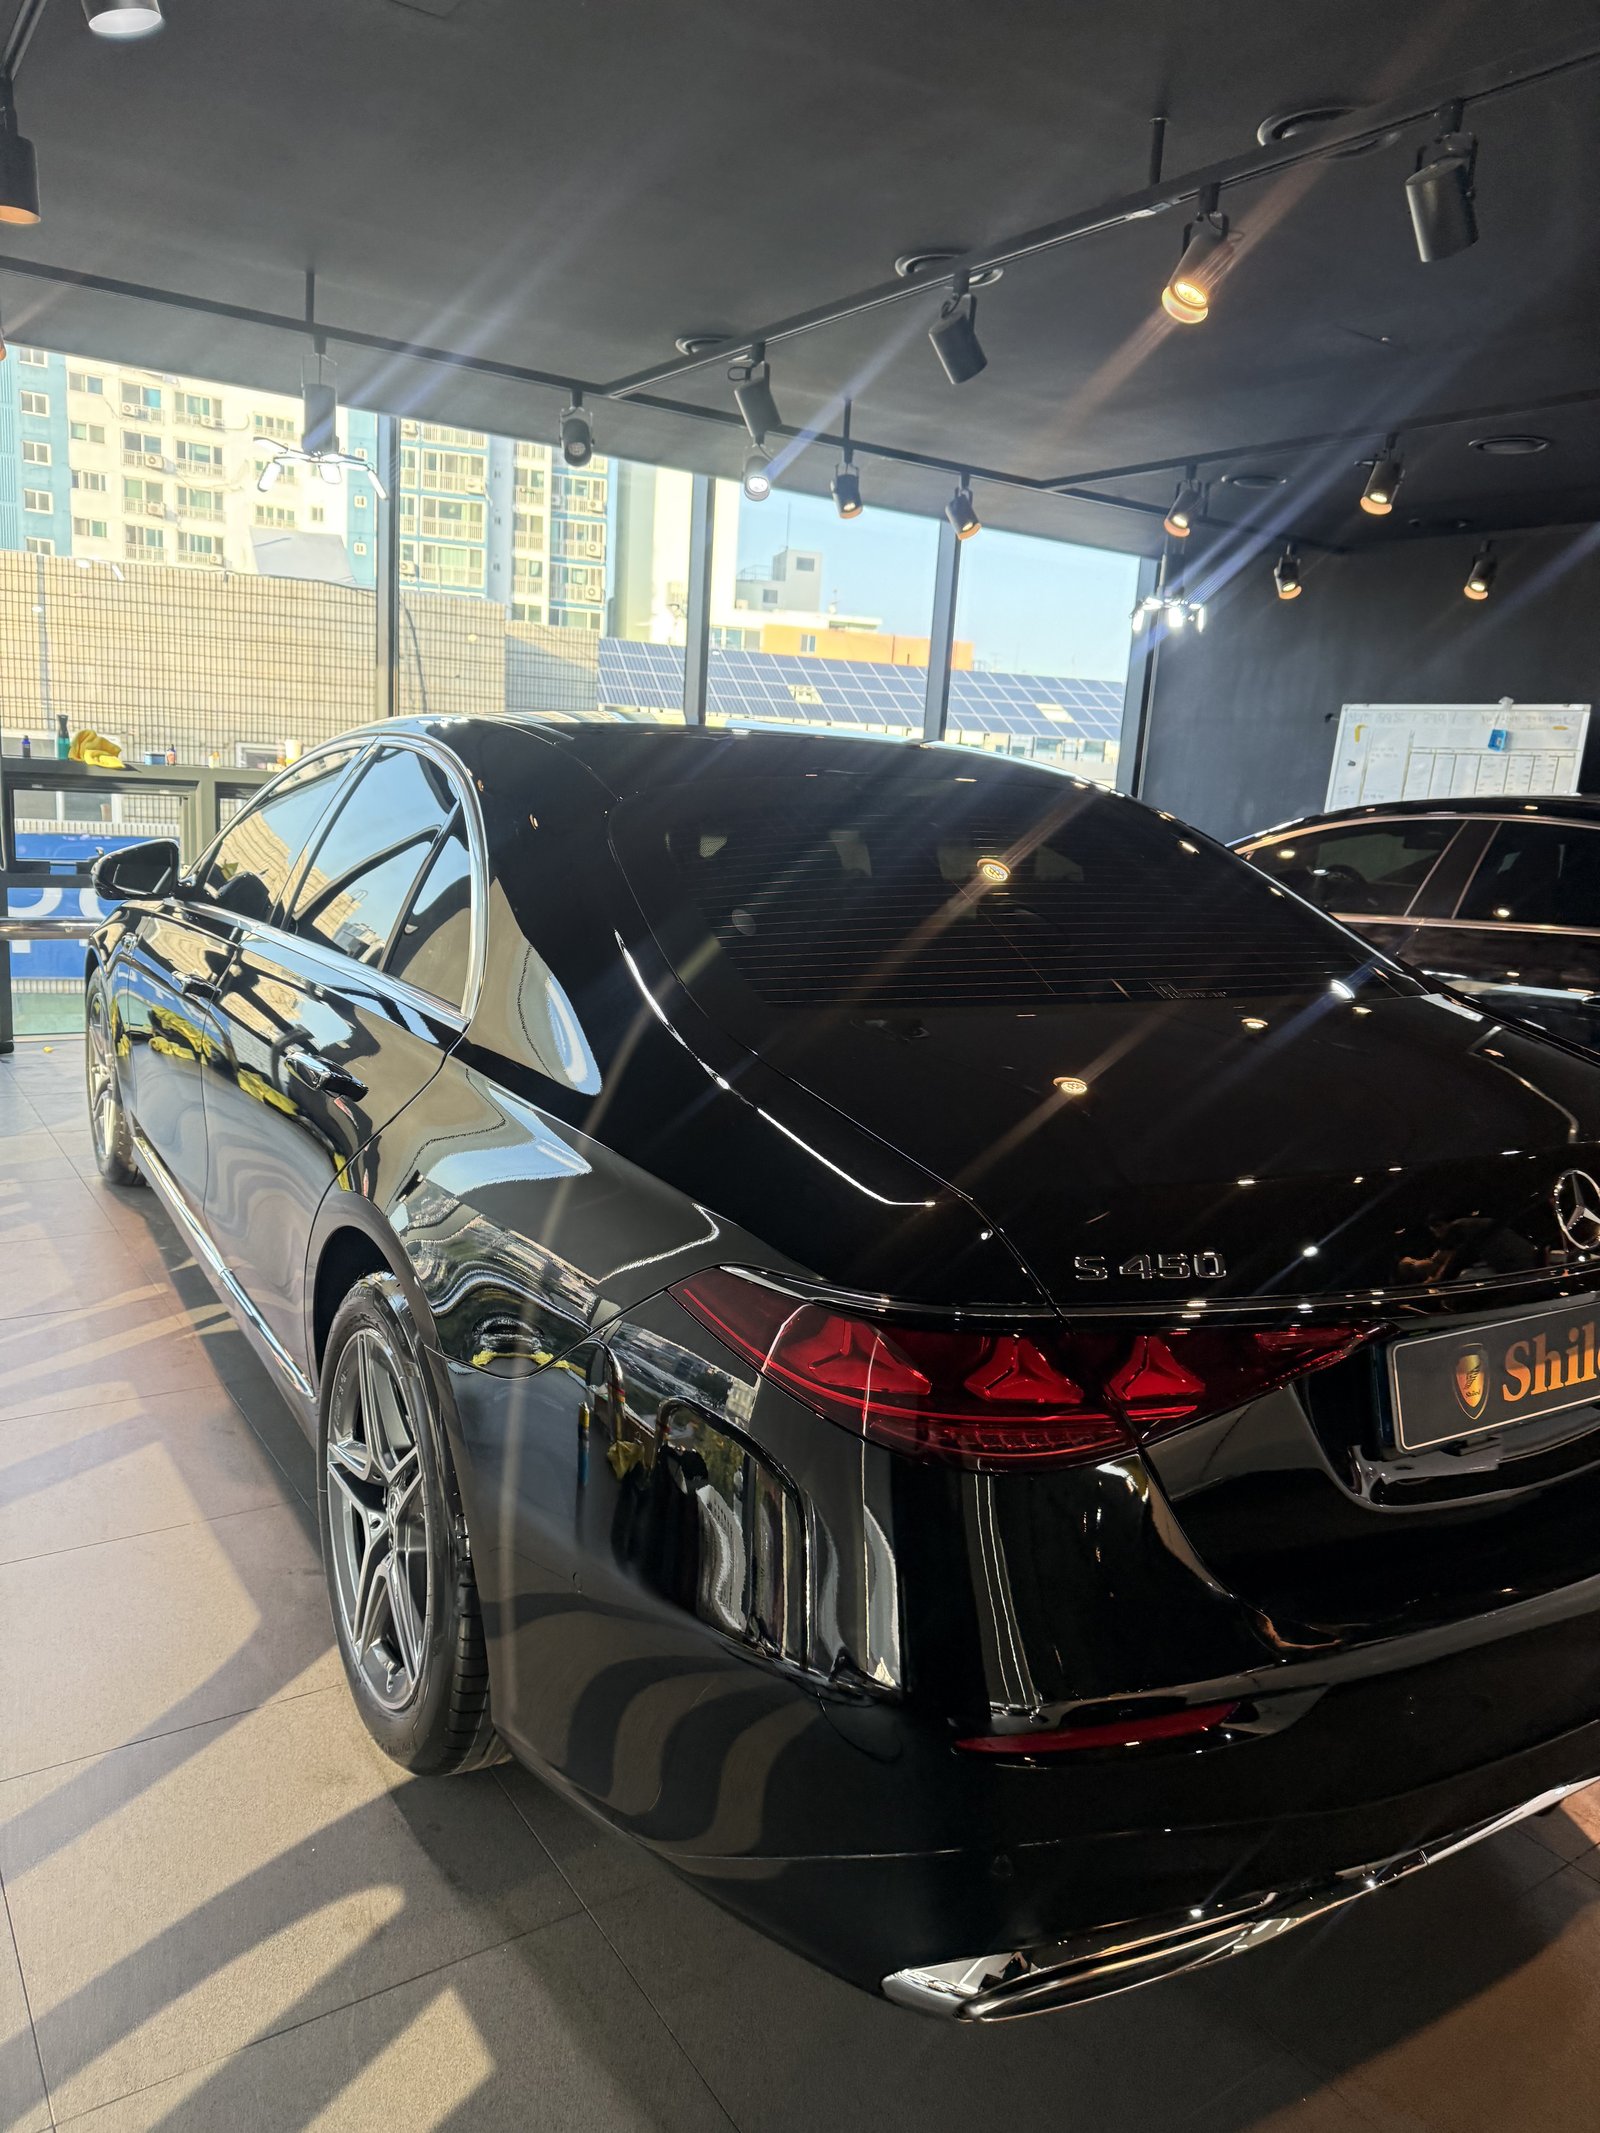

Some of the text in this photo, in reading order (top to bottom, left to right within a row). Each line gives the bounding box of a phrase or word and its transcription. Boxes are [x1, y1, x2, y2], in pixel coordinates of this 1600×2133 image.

[1074, 1252, 1227, 1280] S 450
[1502, 1321, 1600, 1402] Shil
